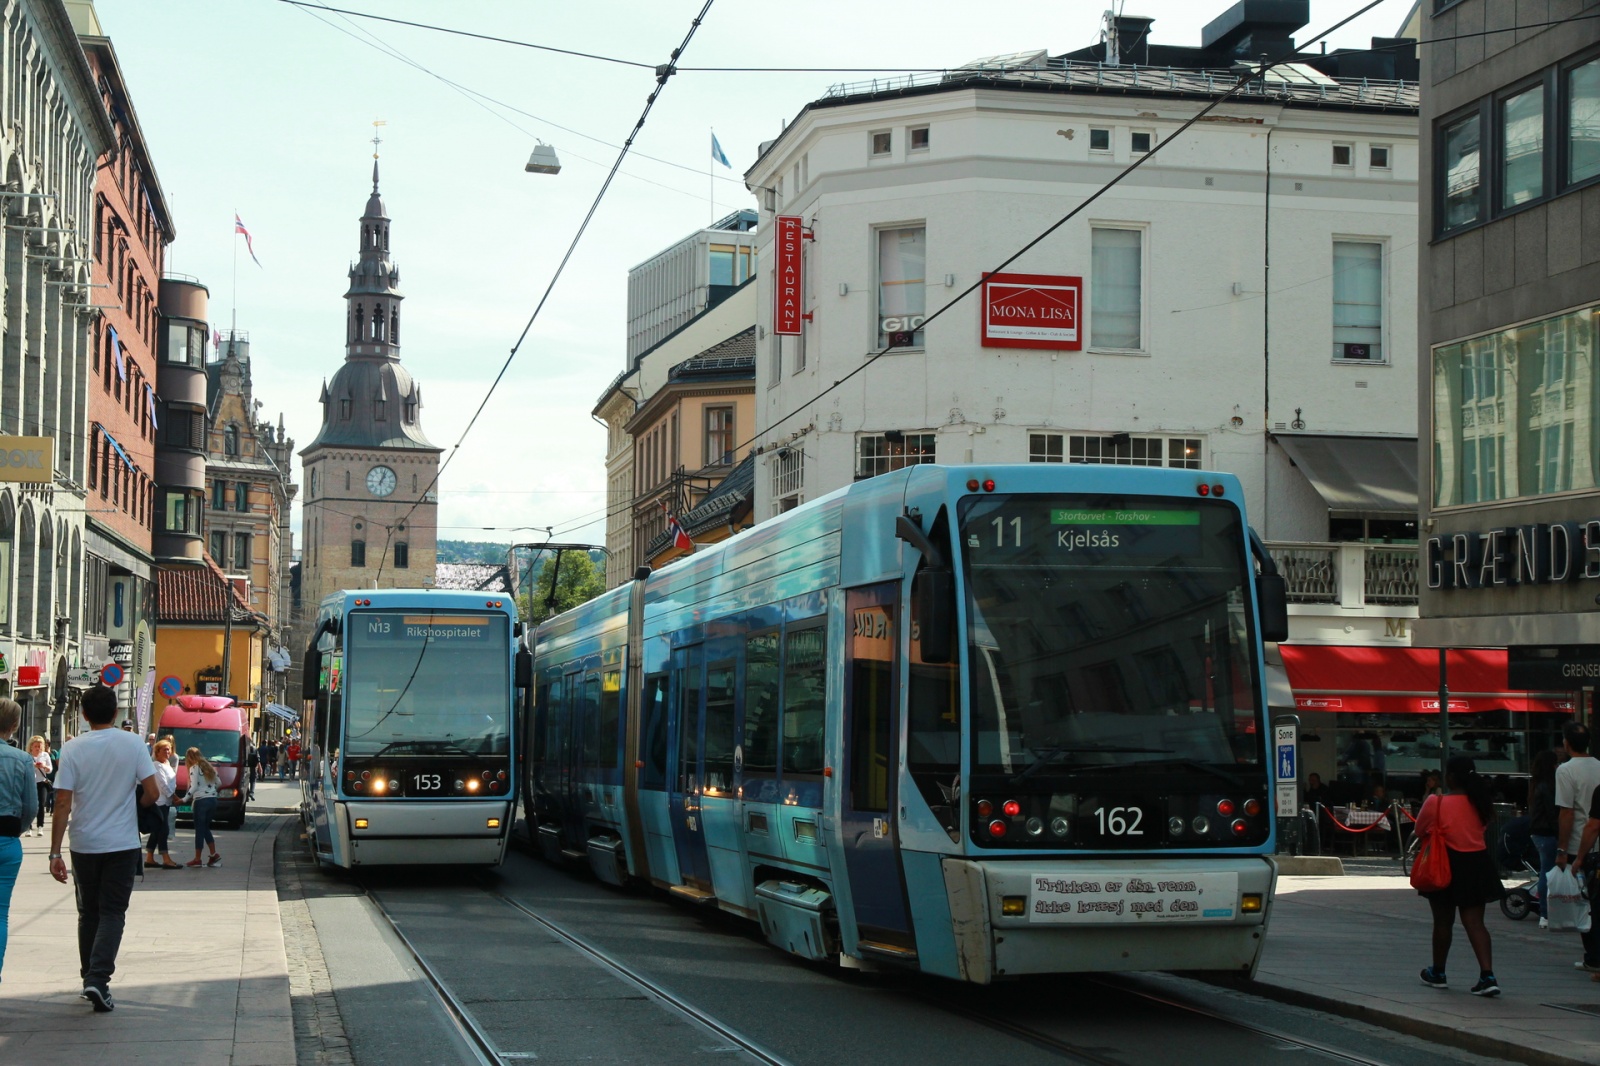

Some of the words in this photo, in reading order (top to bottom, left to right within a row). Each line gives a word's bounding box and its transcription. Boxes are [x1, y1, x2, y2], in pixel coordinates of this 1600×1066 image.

[785, 220, 795, 330] RESTAURANT
[991, 305, 1037, 318] MONA
[1040, 307, 1073, 320] LISA
[1058, 511, 1106, 521] Stortorvet
[1115, 511, 1150, 521] Torshov
[991, 516, 1022, 547] 11
[1058, 529, 1120, 551] Kjelsås
[369, 622, 391, 633] N13
[407, 627, 481, 639] Rikshospitalet
[1562, 663, 1600, 677] GRENSE
[1278, 729, 1293, 740] Sone
[413, 774, 441, 790] 153
[1093, 806, 1144, 836] 162
[1036, 878, 1101, 894] Trikken
[1105, 881, 1122, 893] er
[1126, 879, 1153, 893] din
[1035, 900, 1071, 914] ikke
[1077, 900, 1125, 915] kræsj
[1130, 899, 1163, 913] med
[1170, 899, 1198, 912] den
